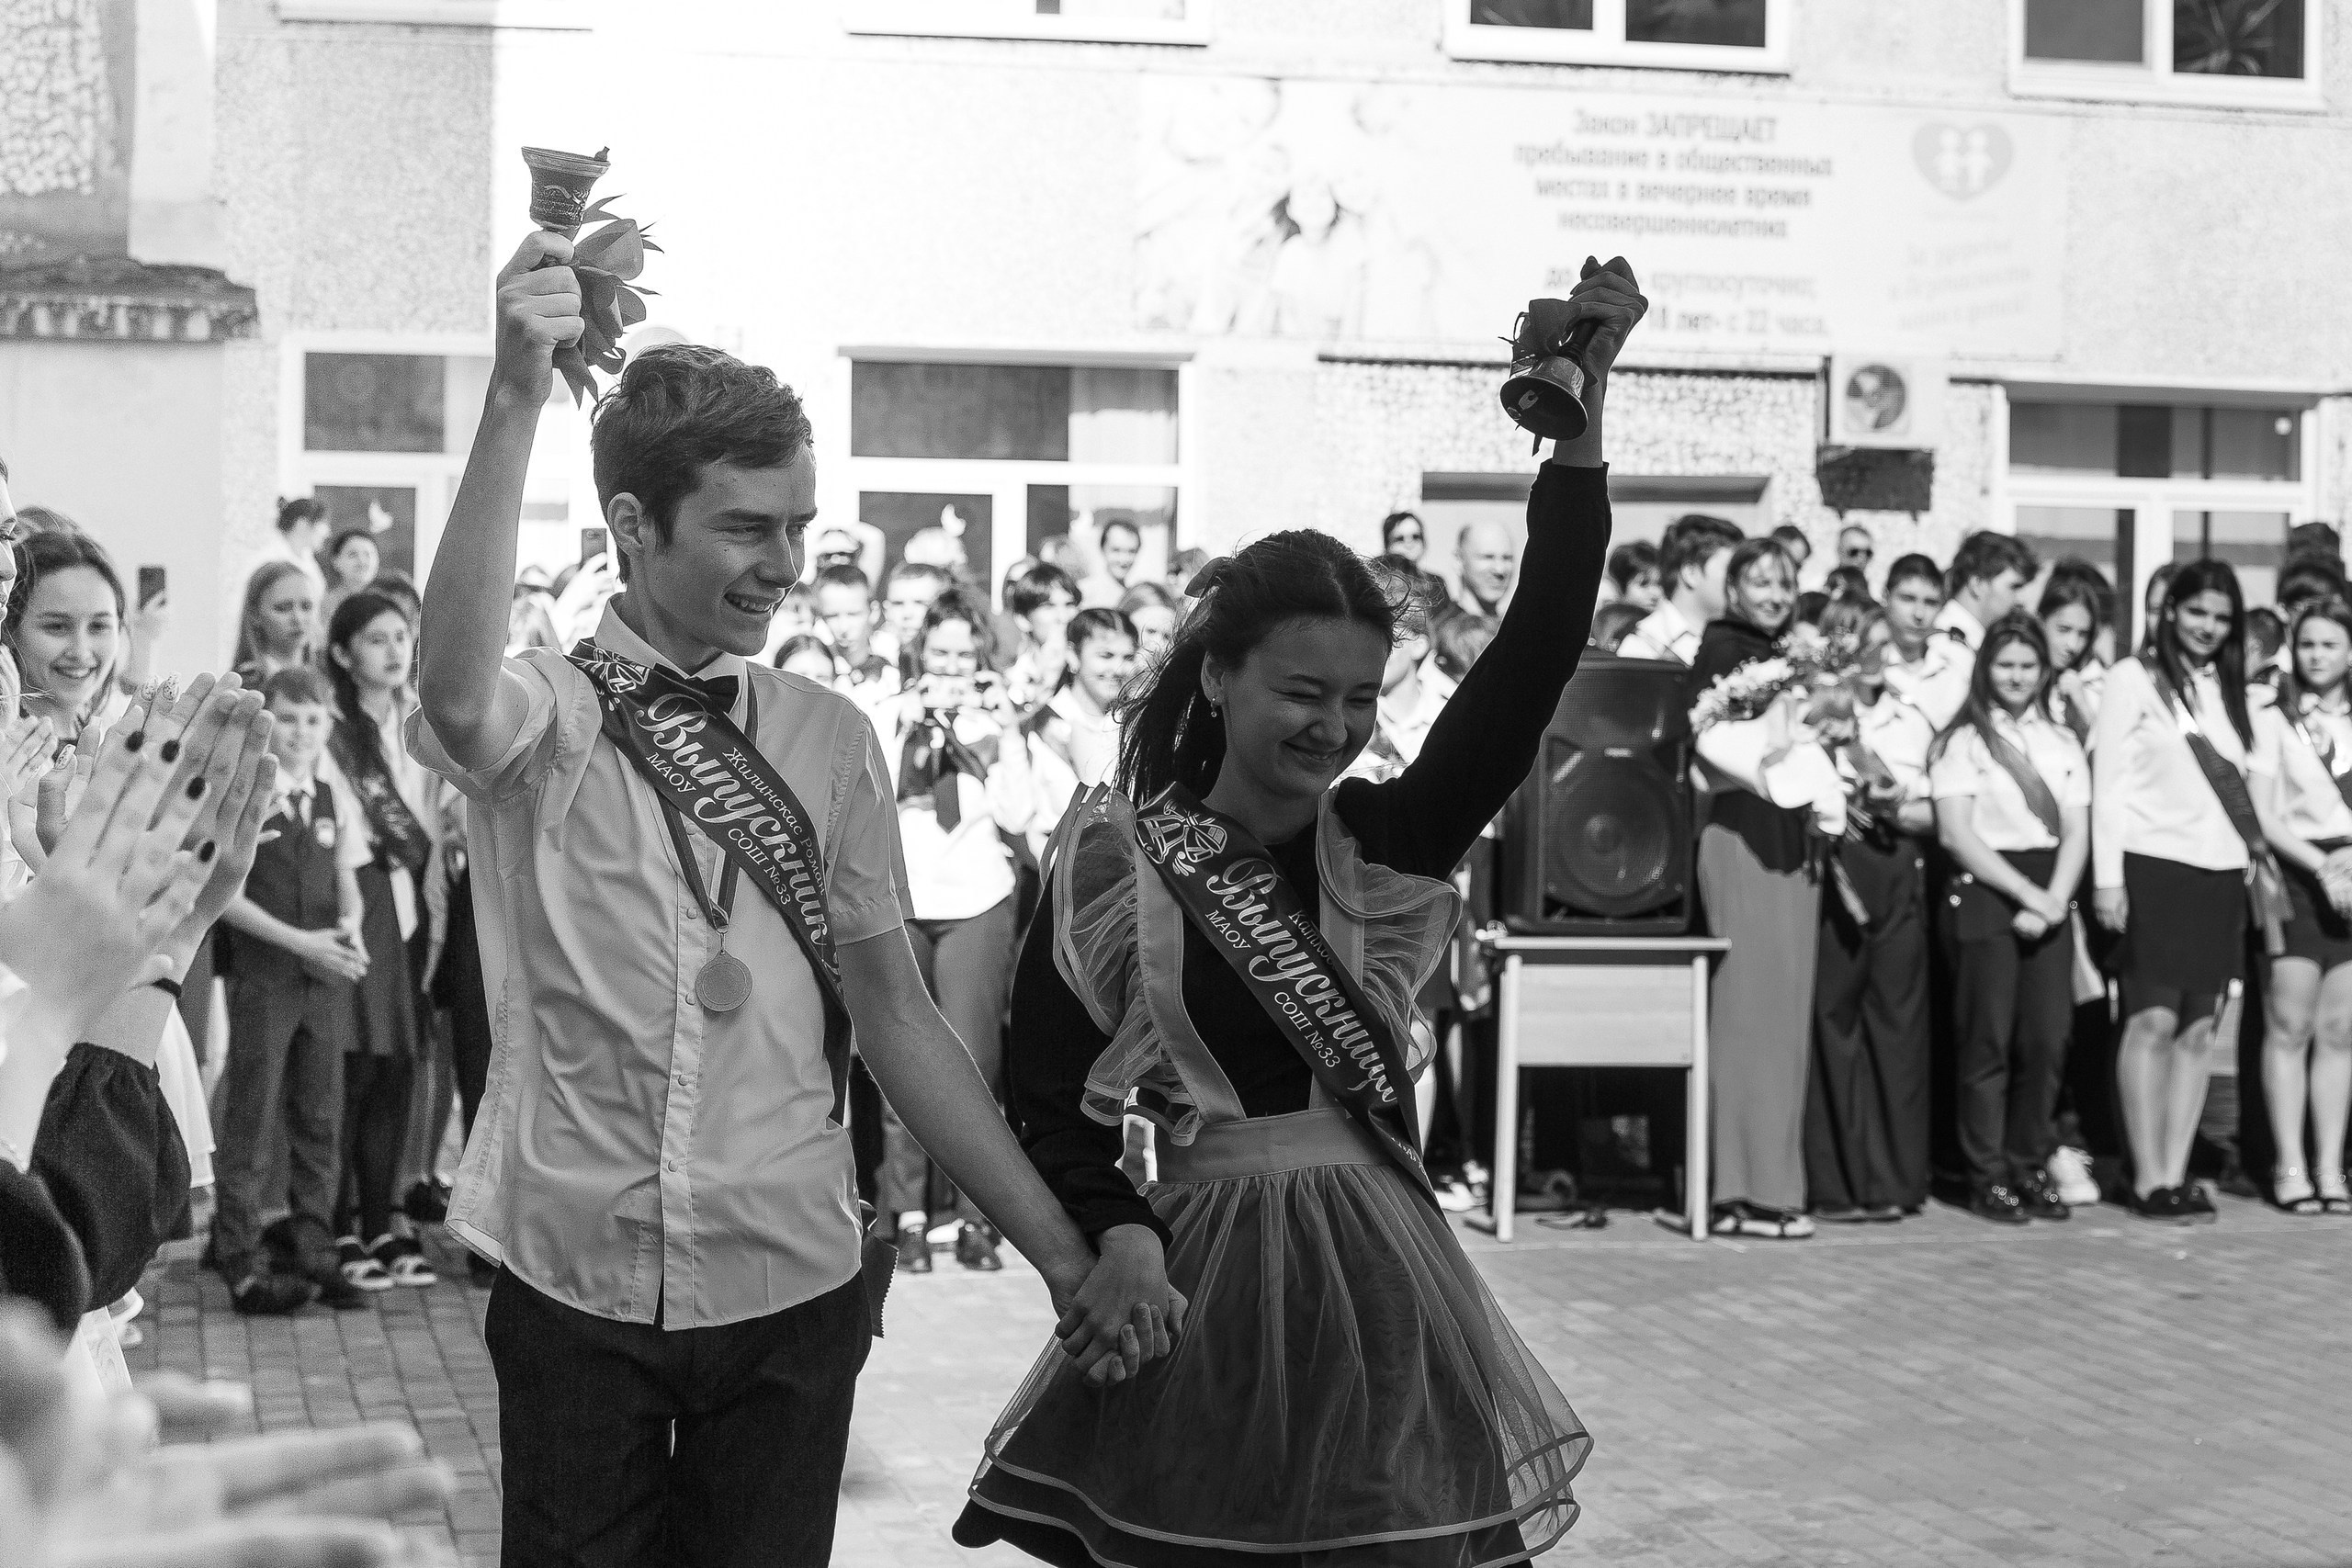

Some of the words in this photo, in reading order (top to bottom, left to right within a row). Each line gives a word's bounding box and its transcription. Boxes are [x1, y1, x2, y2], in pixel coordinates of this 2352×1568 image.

[1513, 138, 1649, 169] пребывание
[1657, 150, 1668, 168] в
[1677, 146, 1833, 176] общественных
[1534, 179, 1609, 199] местах
[1617, 182, 1629, 199] в
[1635, 183, 1736, 209] вечернее
[1743, 186, 1811, 211] время
[1573, 108, 1638, 136] Закон
[1645, 111, 1778, 142] ЗАПРЕЩАЕТ
[634, 694, 828, 946] Выпускник
[646, 752, 696, 793] МАОУ
[728, 828, 769, 865] СОШ
[763, 866, 791, 905] №33
[722, 747, 803, 836] Жилинскас
[800, 838, 826, 896] Роман
[1205, 857, 1398, 1102] Выпускница
[1205, 909, 1251, 950] МАОУ
[1274, 991, 1313, 1031] СОШ
[1304, 1031, 1340, 1068] №33
